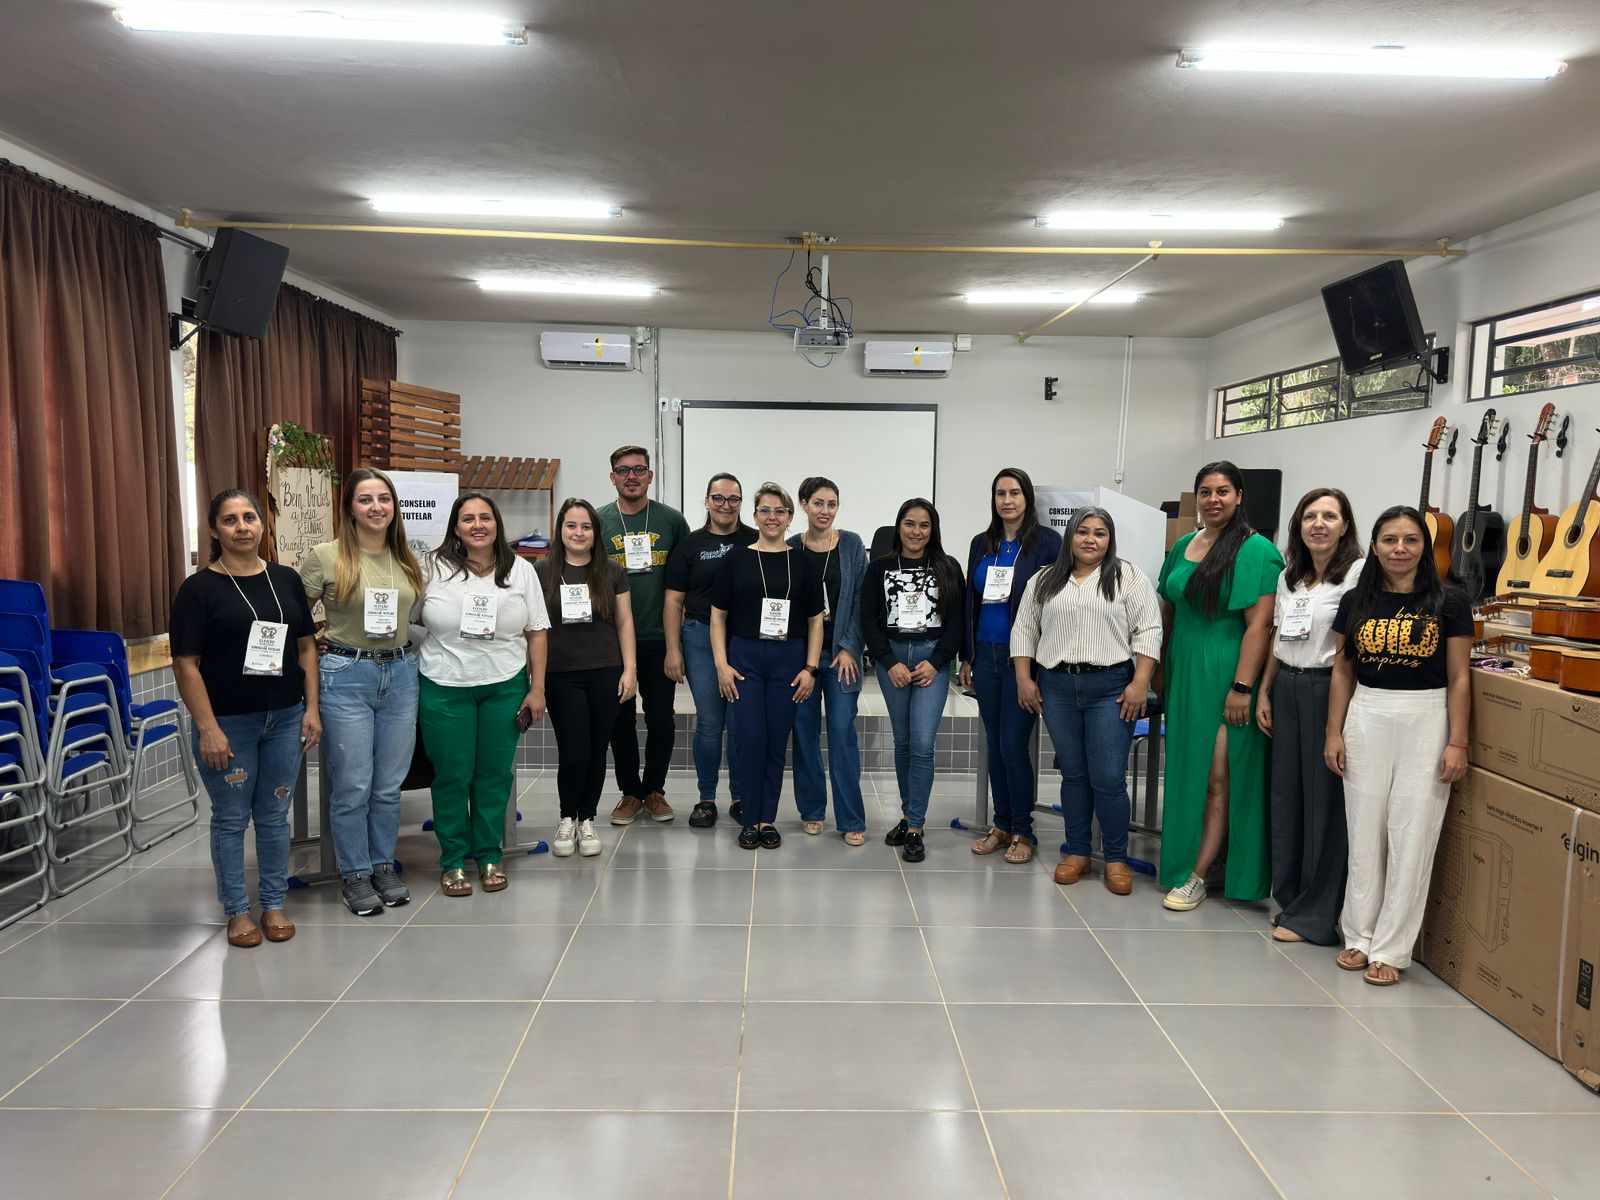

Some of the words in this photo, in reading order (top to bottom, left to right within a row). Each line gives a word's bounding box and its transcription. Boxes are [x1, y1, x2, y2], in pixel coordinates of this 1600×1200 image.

[399, 499, 437, 508] CONSELHO
[402, 512, 433, 521] TUTELAR
[1361, 655, 1422, 671] empires
[1581, 963, 1591, 974] 10
